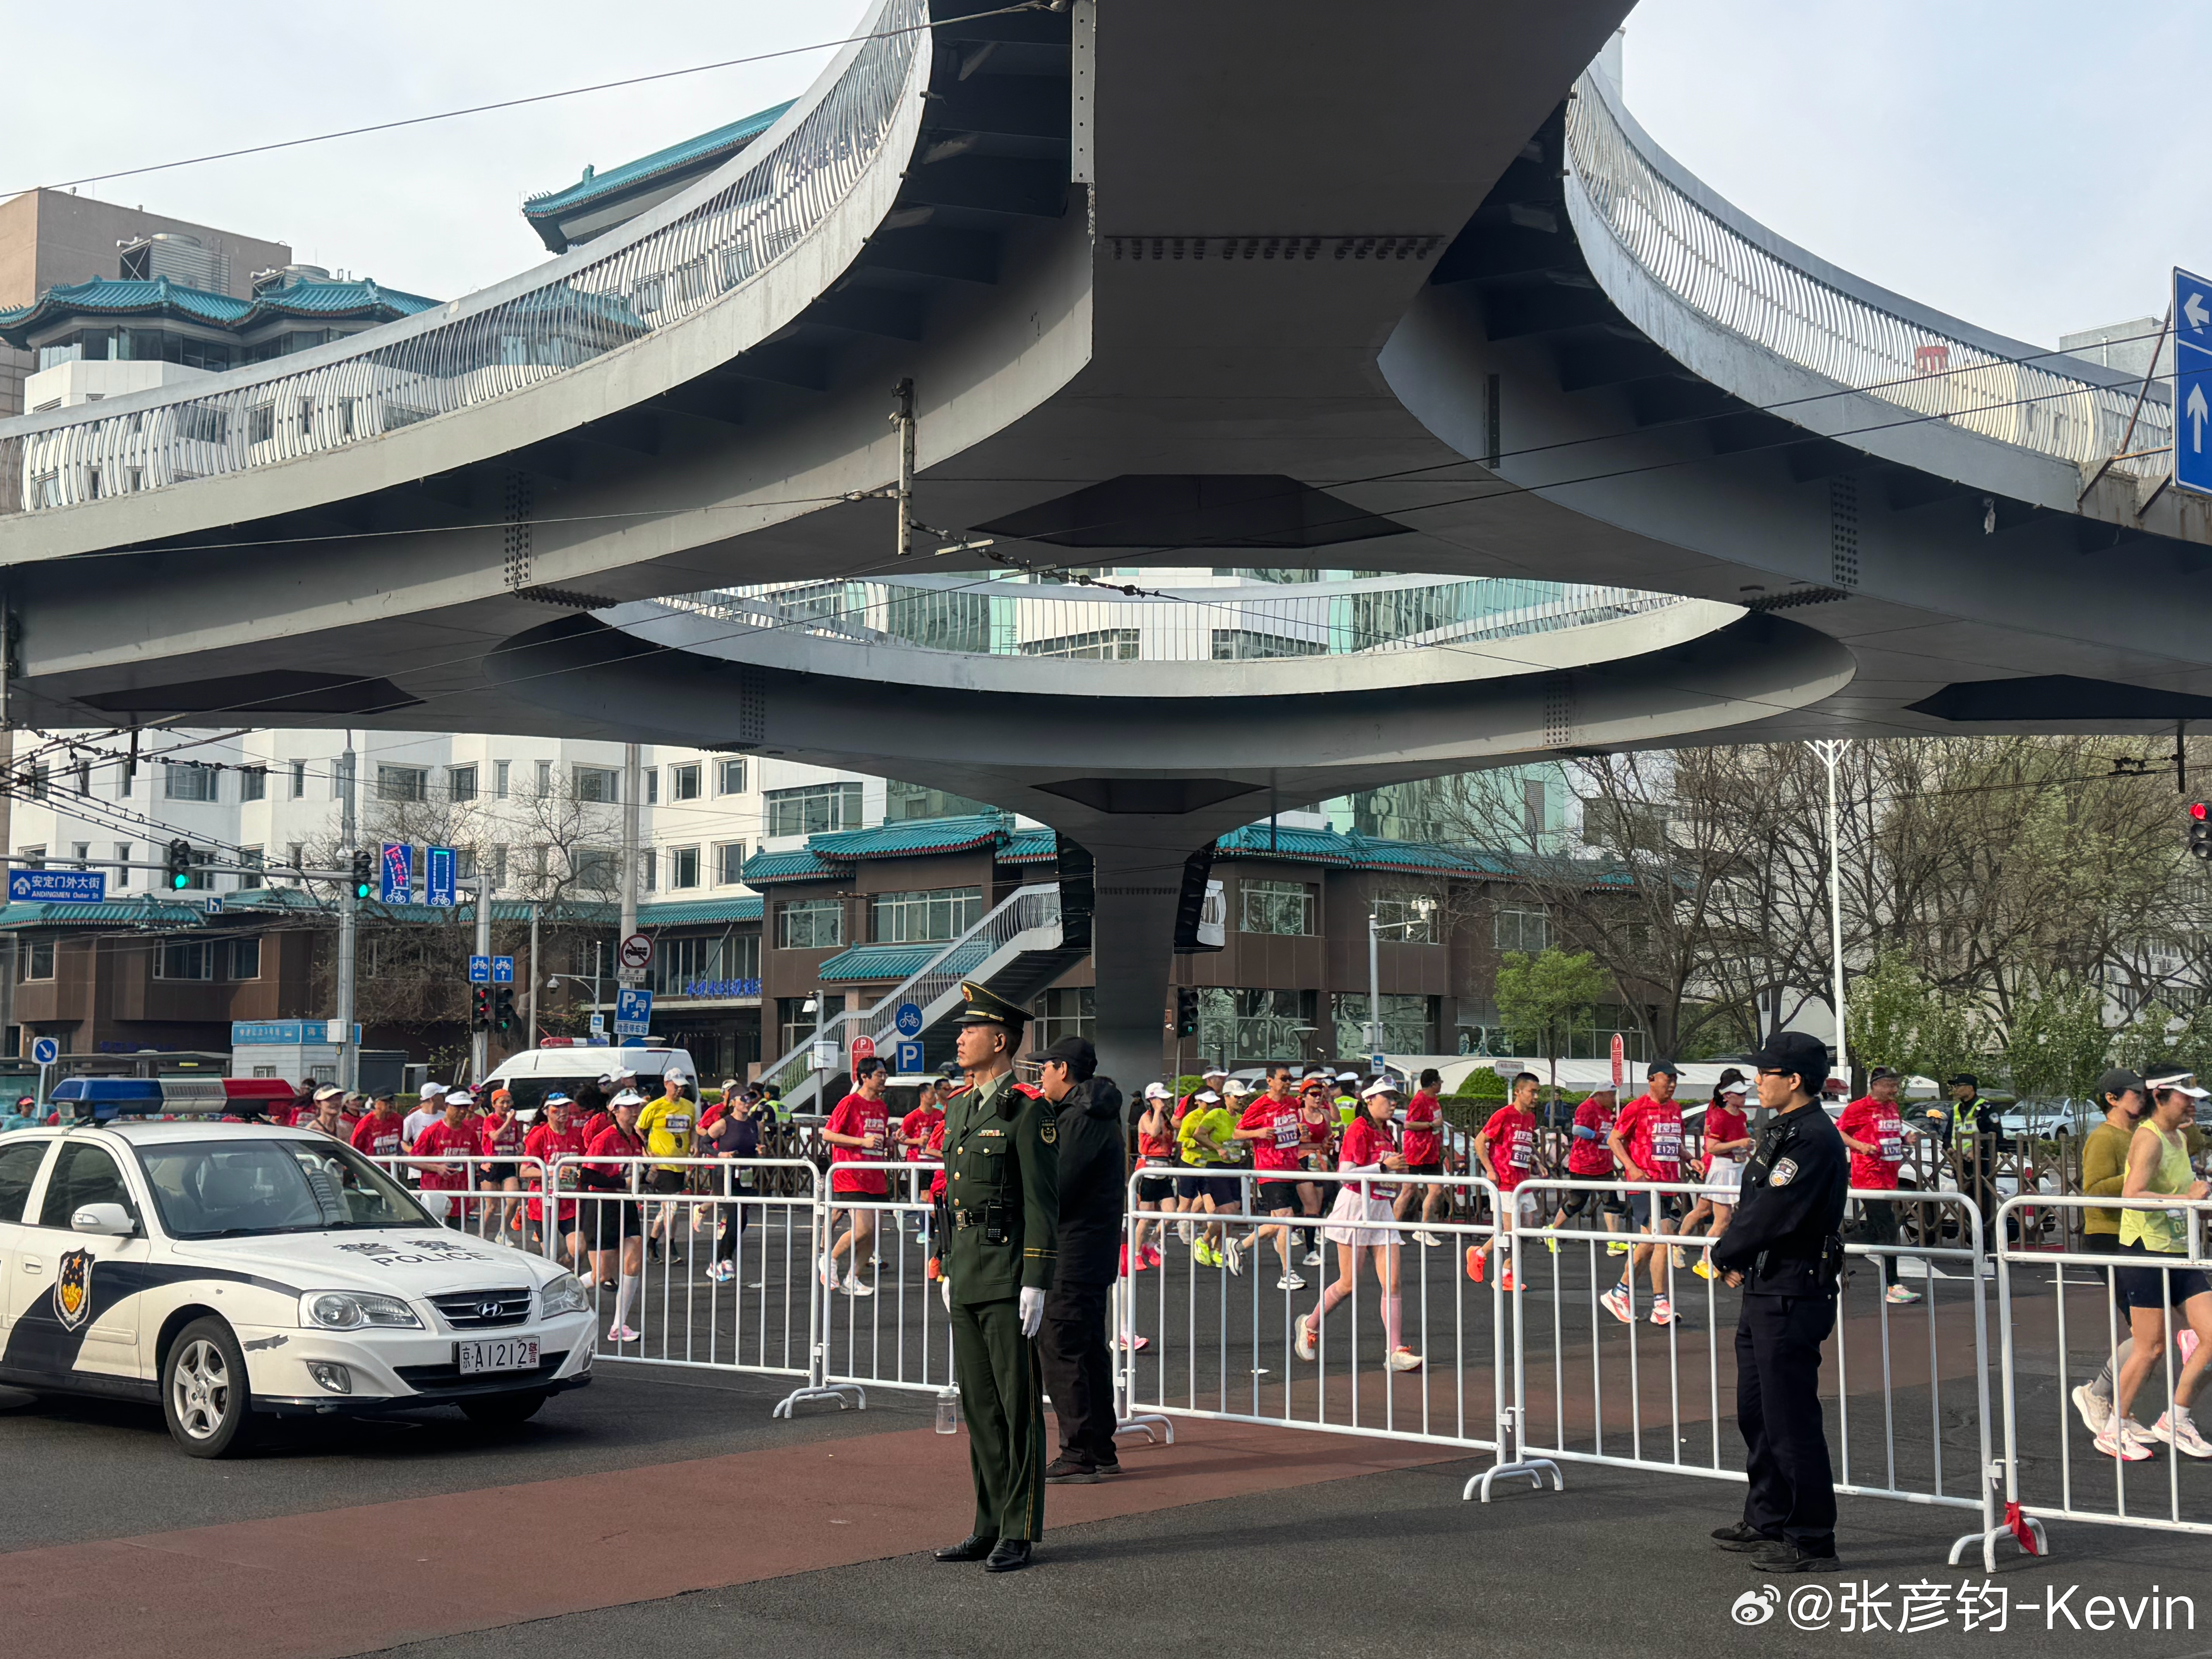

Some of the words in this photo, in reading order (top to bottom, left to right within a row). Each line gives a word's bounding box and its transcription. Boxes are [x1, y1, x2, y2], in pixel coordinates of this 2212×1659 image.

[32, 876, 100, 889] 安定门外大街
[622, 992, 636, 1008] P
[903, 1046, 918, 1068] P
[371, 1252, 494, 1266] POLICE
